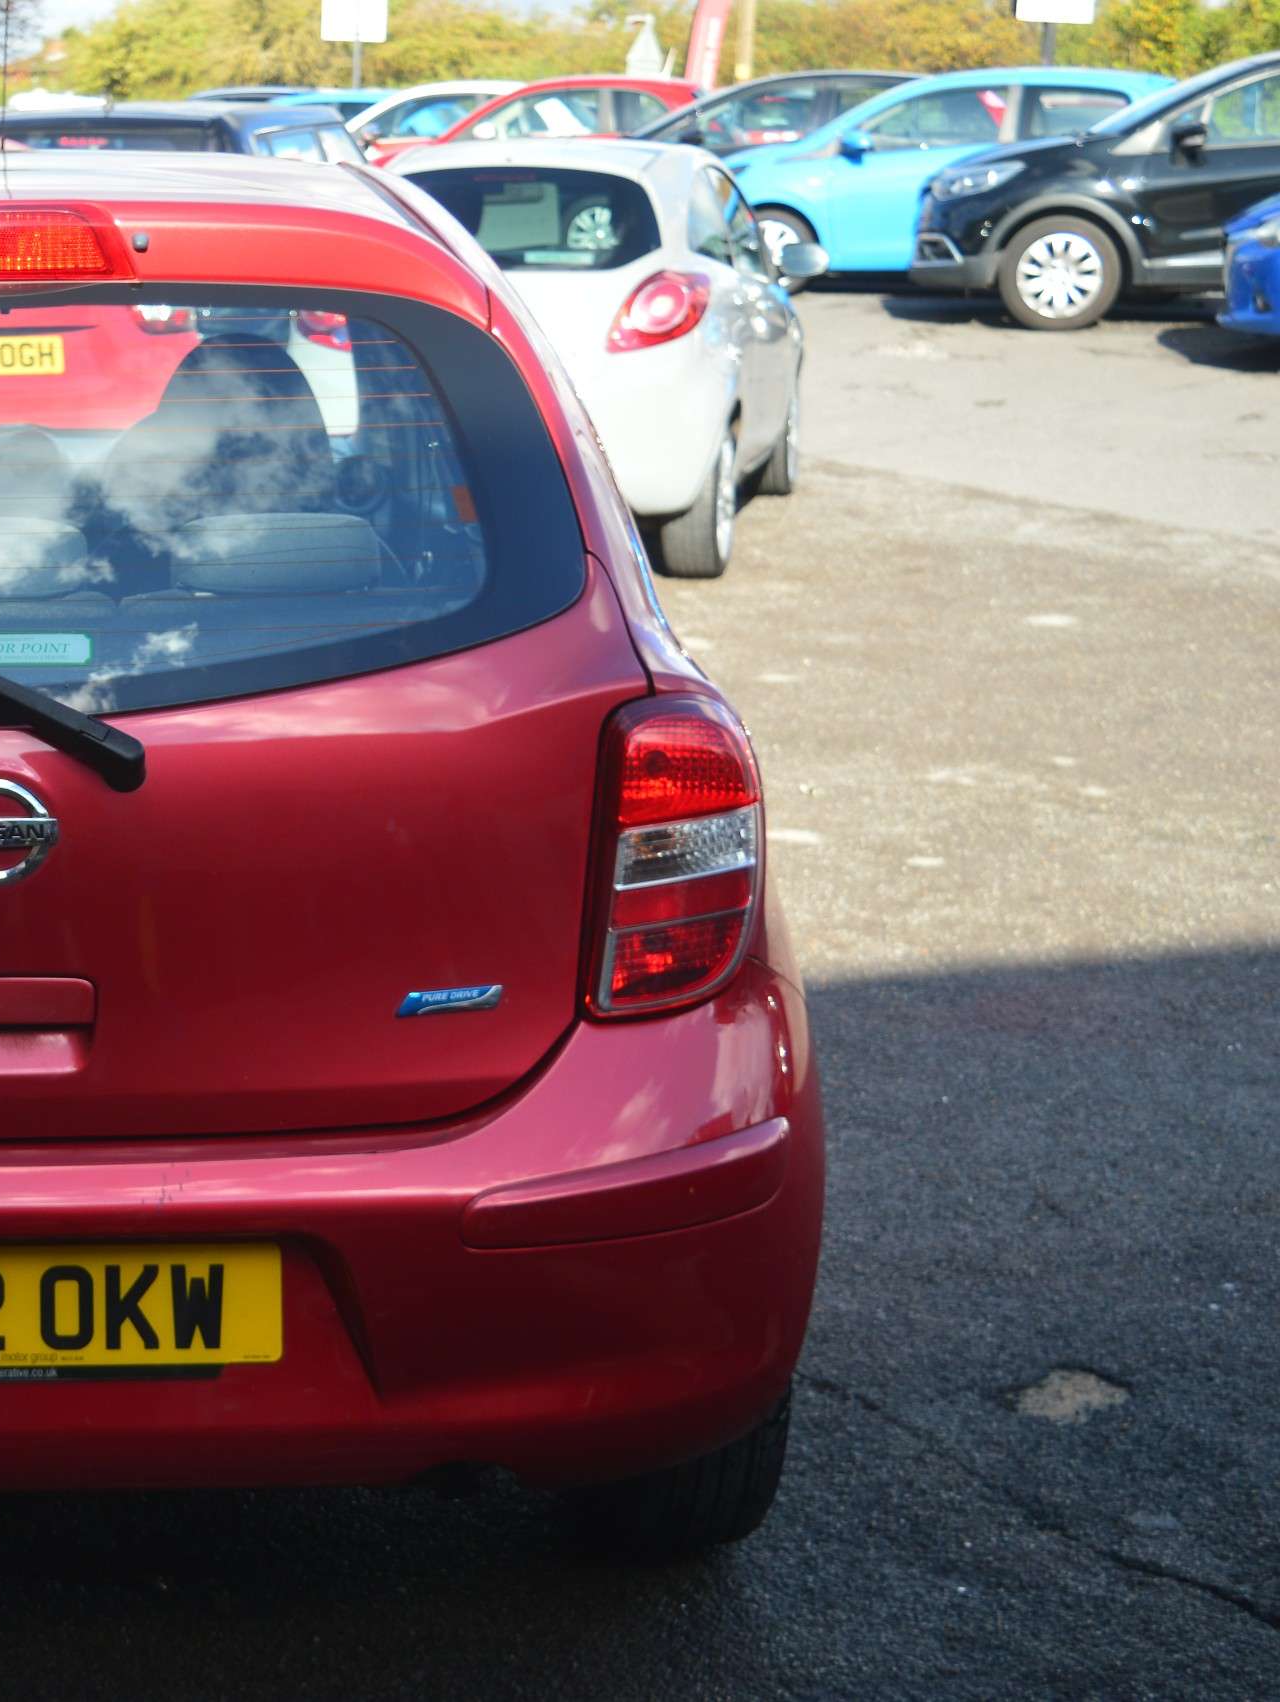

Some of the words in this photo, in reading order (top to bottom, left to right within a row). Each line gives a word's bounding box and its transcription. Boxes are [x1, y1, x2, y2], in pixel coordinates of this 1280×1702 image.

[0, 343, 55, 368] OGH
[18, 642, 71, 654] POINT
[422, 991, 448, 1003] PURE
[450, 989, 480, 1000] DRIVE
[39, 1264, 224, 1350] OKW
[2, 1351, 29, 1362] motor
[30, 1351, 58, 1364] group
